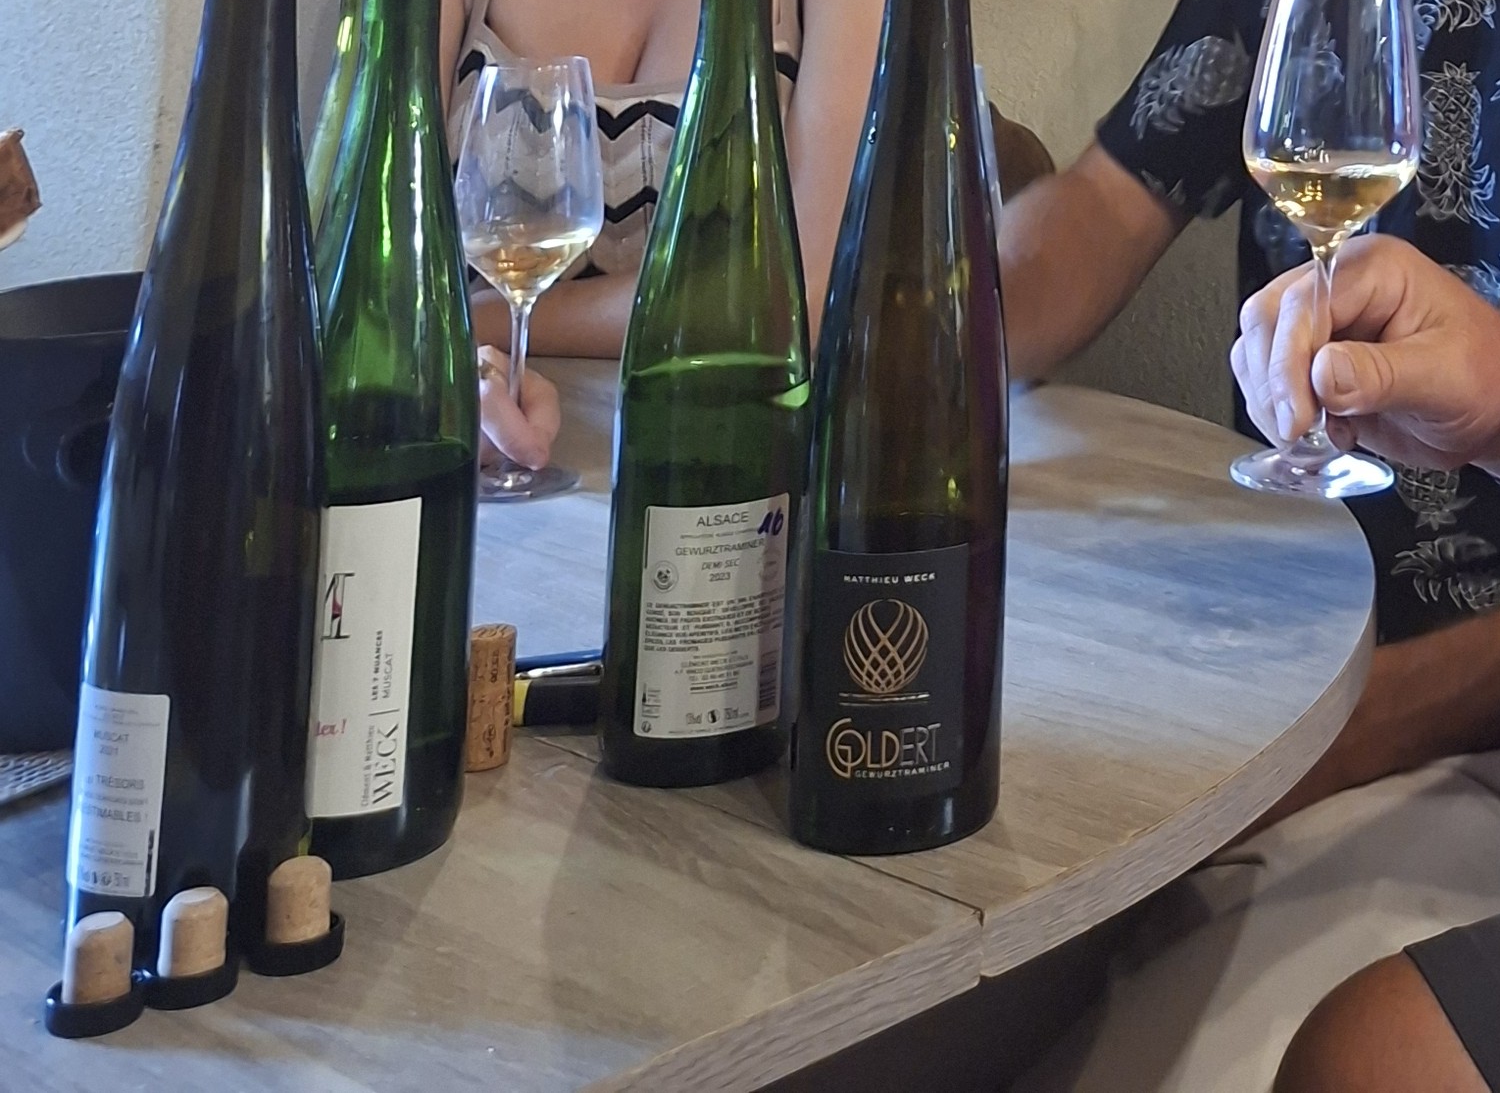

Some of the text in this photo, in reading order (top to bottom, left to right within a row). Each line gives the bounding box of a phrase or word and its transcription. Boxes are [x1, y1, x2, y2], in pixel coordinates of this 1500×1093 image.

[696, 511, 750, 528] ALSACE
[675, 538, 766, 557] GEWURZTRAMINER
[725, 558, 741, 568] SEC
[843, 572, 937, 584] MATTHIEU WECK
[373, 630, 384, 674] NUANCES
[381, 653, 394, 699] MUSCAT
[371, 723, 399, 805] WECK
[855, 761, 951, 779] GEWURZTRAMINER
